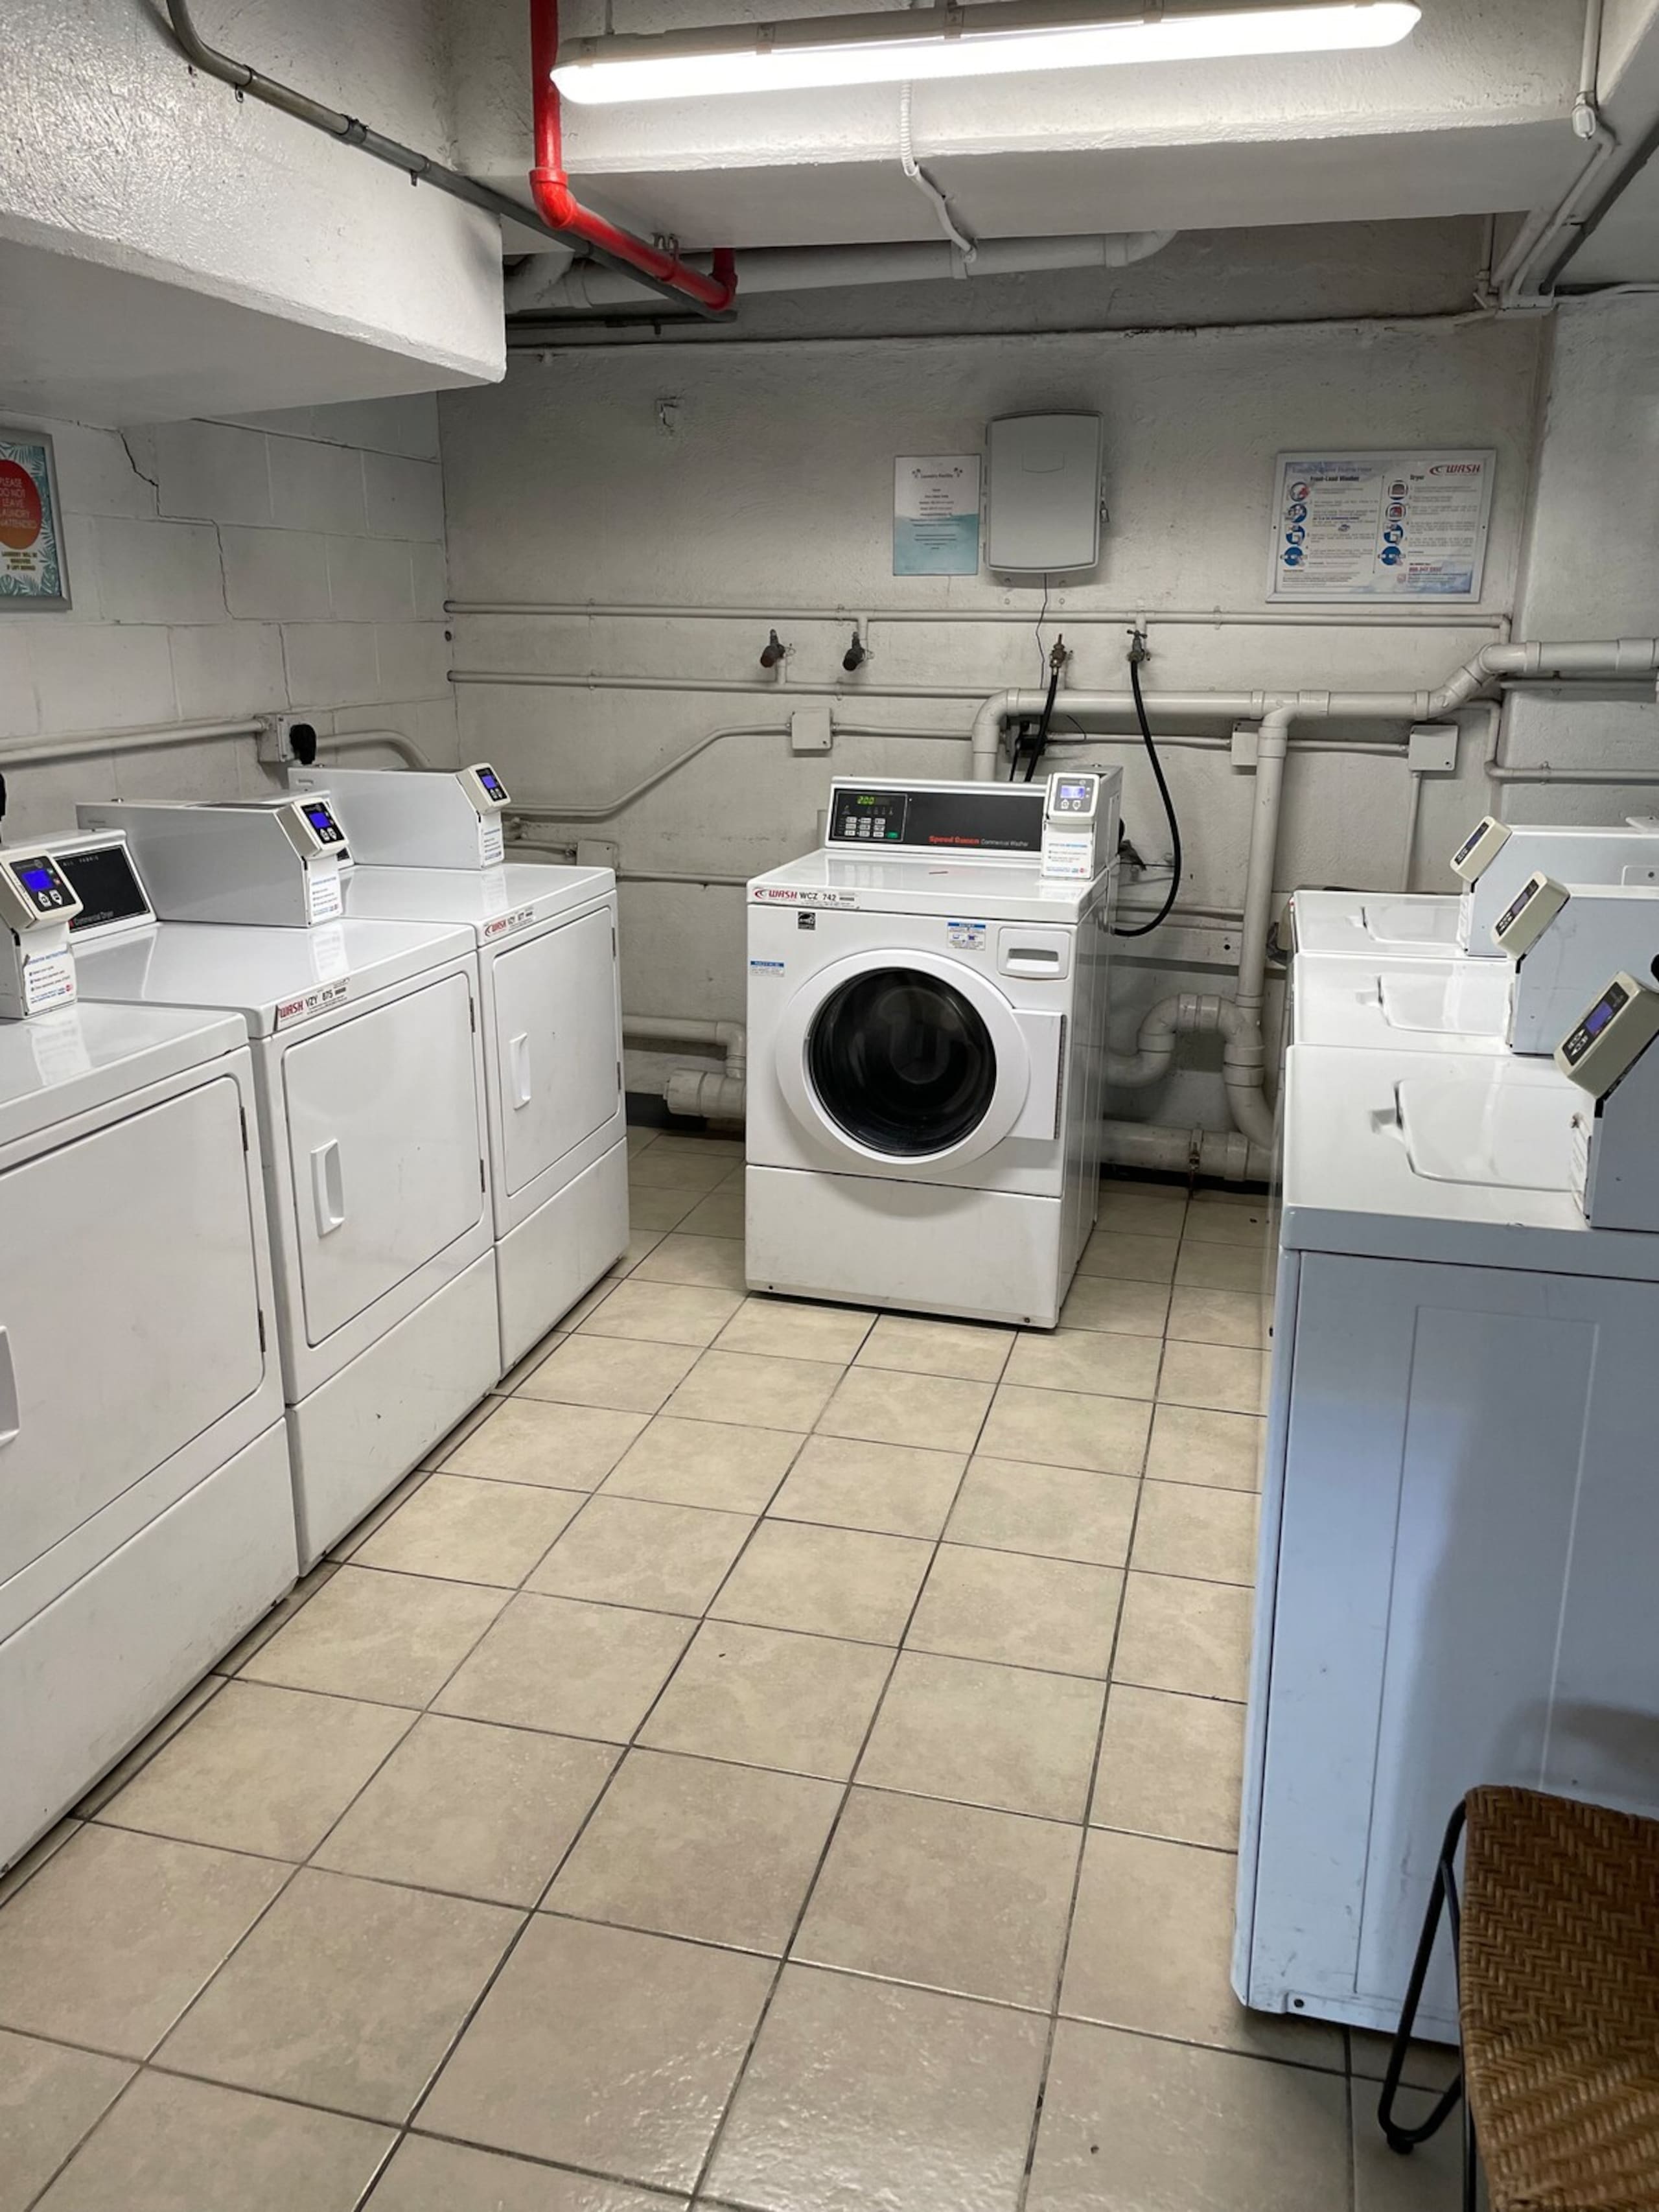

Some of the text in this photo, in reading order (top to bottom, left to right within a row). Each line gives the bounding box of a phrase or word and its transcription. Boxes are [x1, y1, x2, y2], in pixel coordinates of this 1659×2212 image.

[1446, 464, 1481, 473] WASH
[769, 890, 798, 899] WASH
[799, 892, 818, 900] WCZ
[280, 999, 303, 1018] WASH
